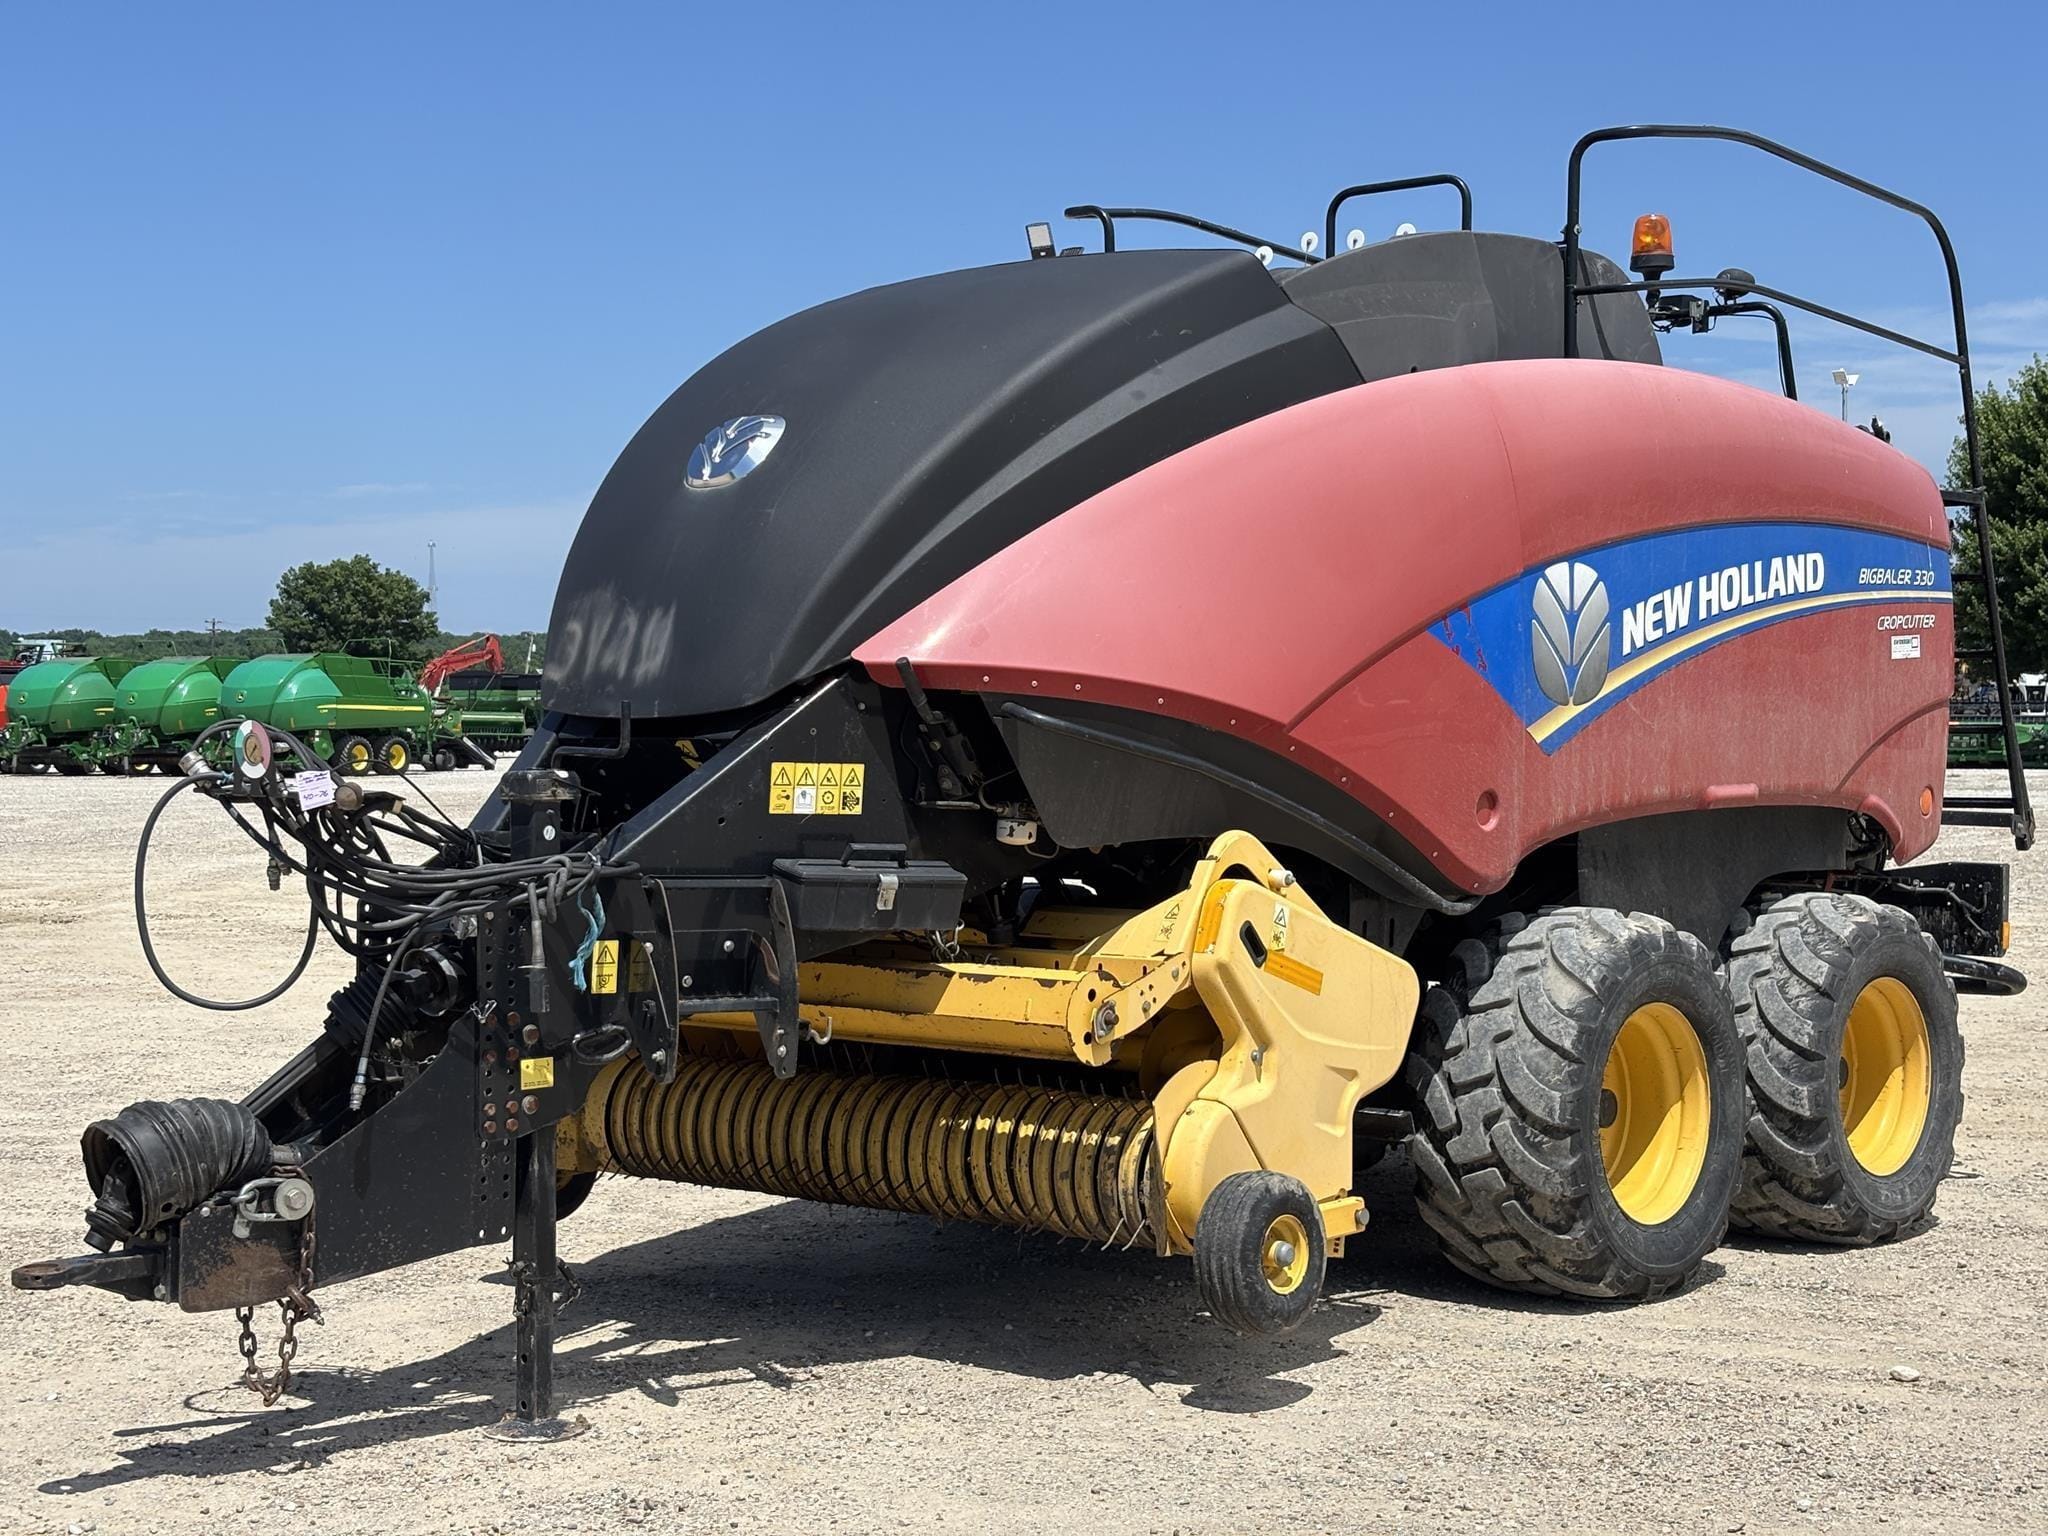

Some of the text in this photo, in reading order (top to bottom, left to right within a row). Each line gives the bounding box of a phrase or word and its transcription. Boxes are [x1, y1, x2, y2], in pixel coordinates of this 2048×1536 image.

[1859, 568, 1935, 586] BIGBALER 330
[1621, 552, 1825, 656] NEW HOLLAND
[1878, 614, 1936, 630] CROPCUTTER
